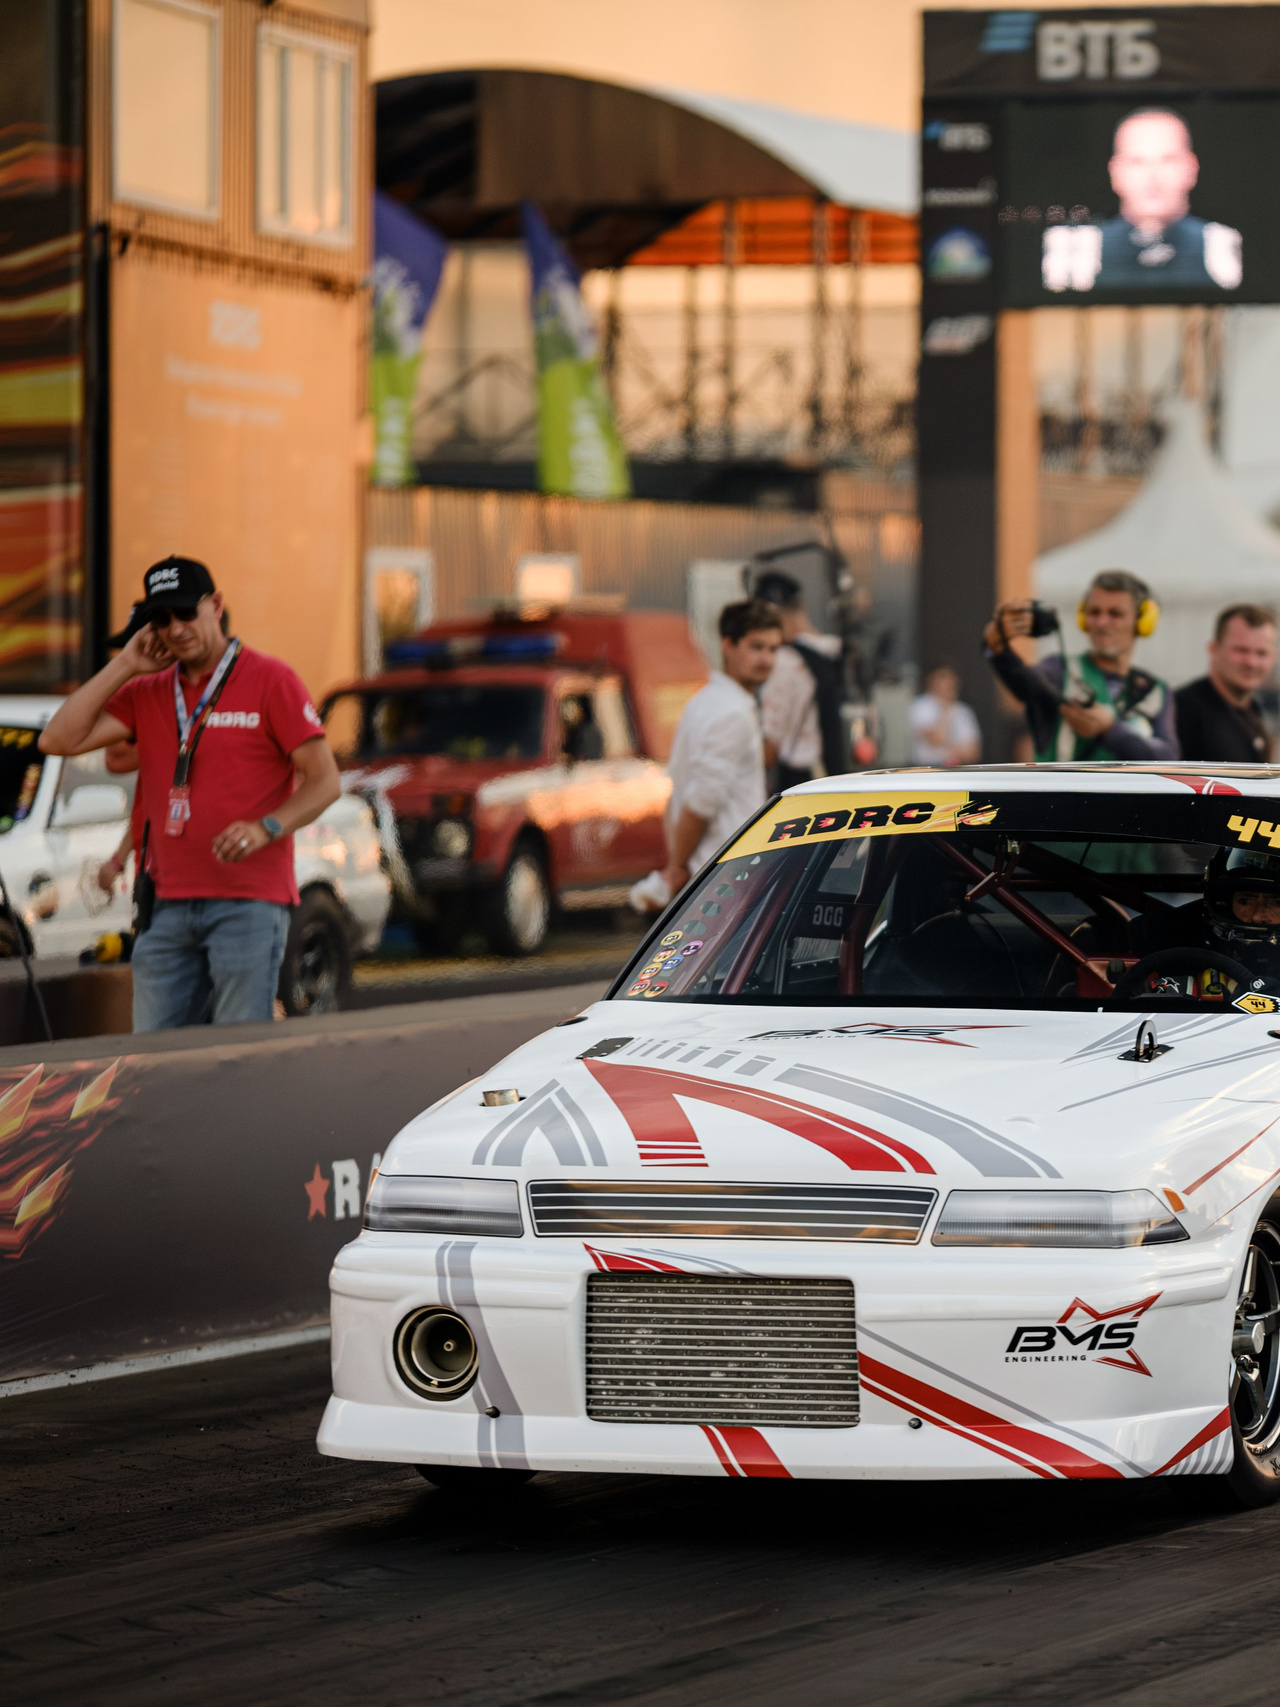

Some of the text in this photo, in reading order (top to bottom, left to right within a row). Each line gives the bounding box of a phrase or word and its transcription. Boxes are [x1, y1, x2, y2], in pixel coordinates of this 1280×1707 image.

[1036, 19, 1160, 82] ВТБ
[767, 802, 936, 843] RDRC
[1250, 1000, 1267, 1009] 44
[1005, 1320, 1139, 1353] BMS
[1004, 1354, 1087, 1363] ENGINEERING
